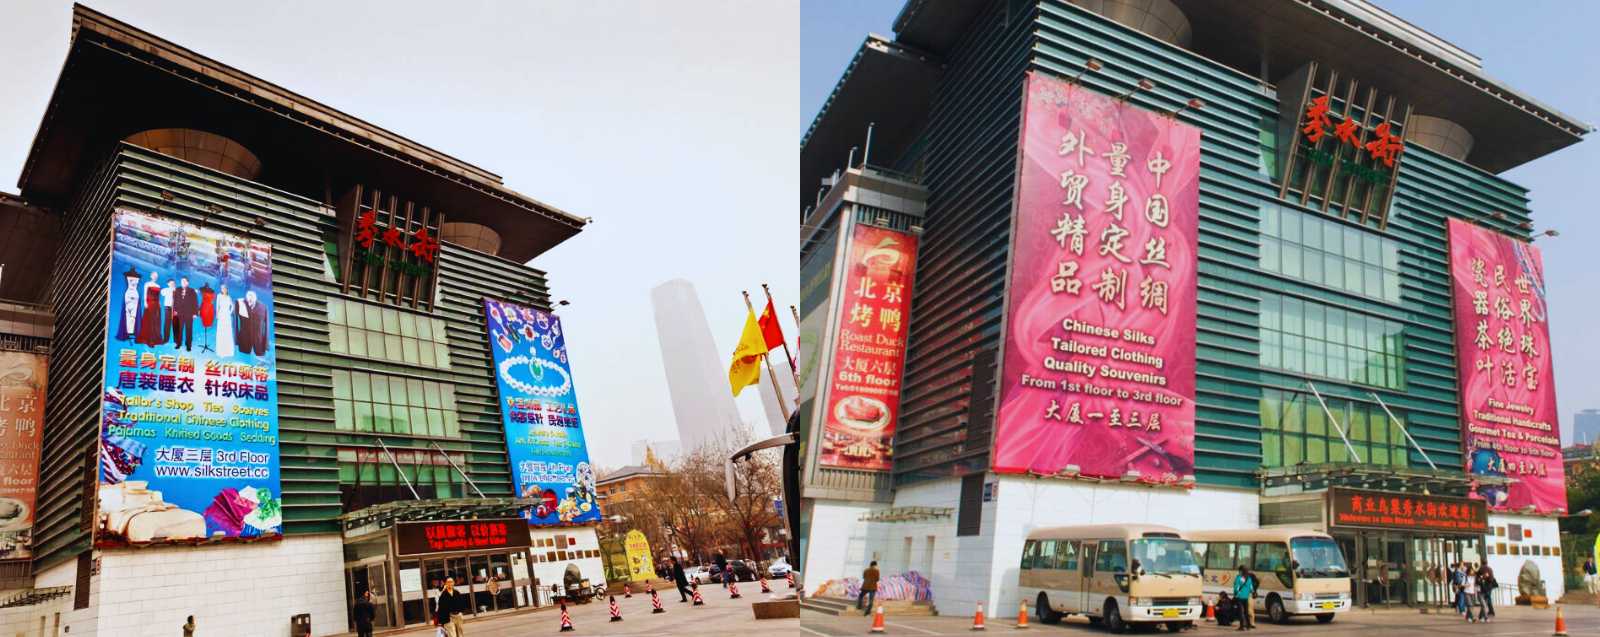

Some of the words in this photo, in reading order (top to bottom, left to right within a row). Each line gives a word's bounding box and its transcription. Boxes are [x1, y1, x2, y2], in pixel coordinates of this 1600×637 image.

[1050, 130, 1095, 296] 外贸精品
[1091, 142, 1132, 310] 量身定制
[1139, 151, 1172, 316] 中国丝绸
[854, 277, 904, 303] 北京
[848, 303, 902, 333] 烤鸭
[1062, 318, 1119, 339] Chinese
[1122, 329, 1155, 345] Silks
[1472, 257, 1494, 385] 瓷器茶叶
[1494, 264, 1517, 387] 民俗绝活
[1514, 274, 1539, 391] 世界珠宝
[839, 340, 899, 357] Restaurant
[840, 329, 873, 343] Roast
[876, 334, 904, 347] Duck
[1051, 337, 1107, 357] Tailored
[1111, 347, 1163, 368] Clothing
[119, 348, 195, 374] 量身定制
[843, 357, 897, 375] 大厦六层
[1044, 357, 1096, 377] Quality
[1100, 365, 1166, 386] Souvenirs
[117, 371, 195, 394] 唐装睡衣
[204, 379, 270, 401] 针织床品
[839, 371, 862, 383] 6th
[865, 374, 897, 387] floor
[1021, 375, 1056, 389] From
[1060, 379, 1081, 393] 1st
[1084, 382, 1113, 397] floor
[1117, 388, 1129, 399] to
[1133, 390, 1152, 402] 3rd
[1155, 393, 1183, 407] floor
[1044, 400, 1161, 432] 大厦一至三层
[1488, 398, 1504, 409] Fine
[156, 447, 212, 462] 大厦三层
[216, 449, 237, 463] 3rd
[239, 451, 269, 465] Floor
[156, 463, 269, 478] www.silkstreet.cc
